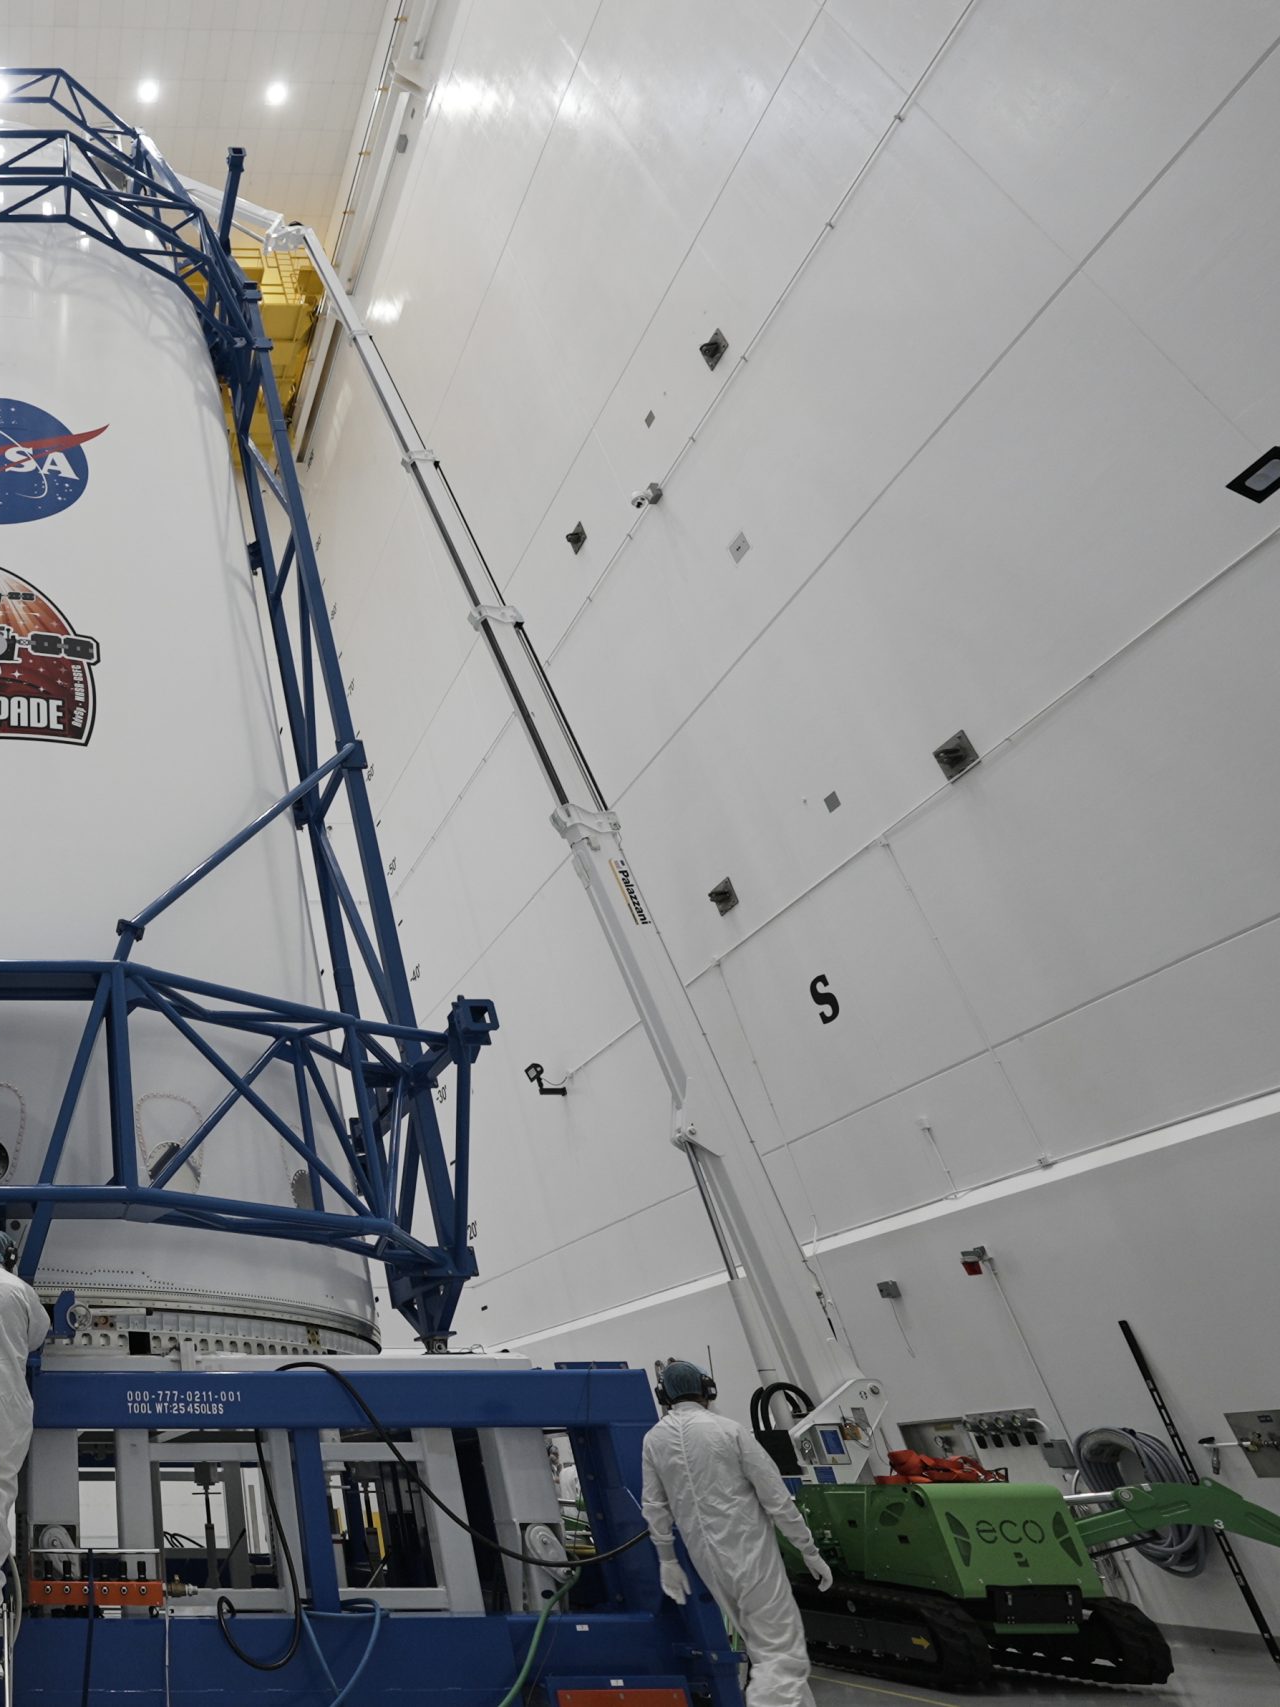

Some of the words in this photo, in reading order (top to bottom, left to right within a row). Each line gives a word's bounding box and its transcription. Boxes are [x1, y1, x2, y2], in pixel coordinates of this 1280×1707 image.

[619, 869, 651, 925] Palazzani
[809, 973, 840, 1025] S
[127, 1402, 152, 1414] TOOL
[975, 1519, 1046, 1545] eco
